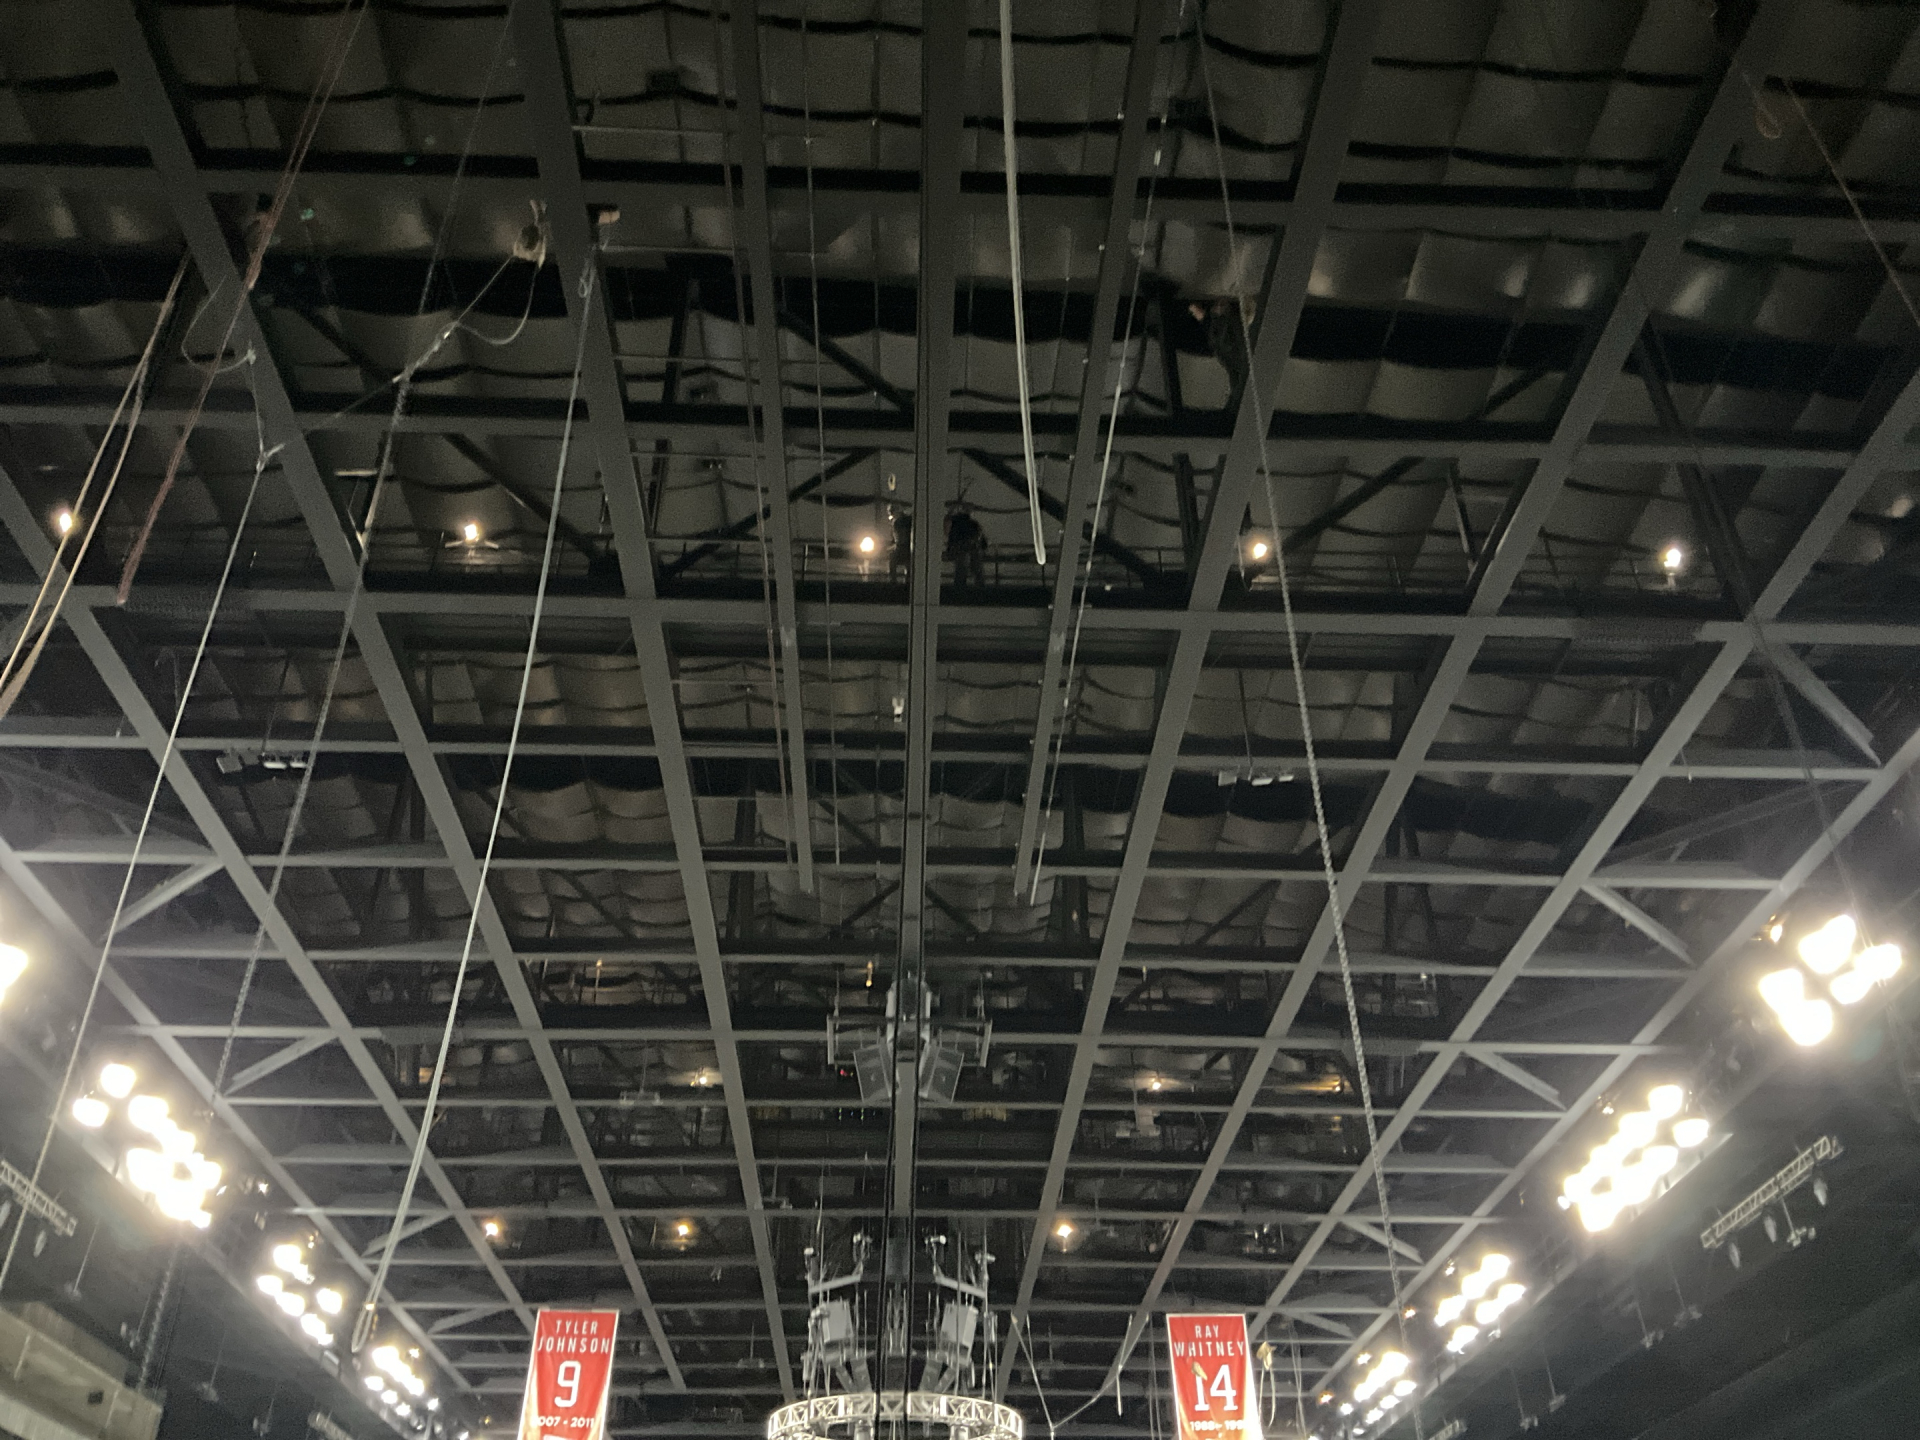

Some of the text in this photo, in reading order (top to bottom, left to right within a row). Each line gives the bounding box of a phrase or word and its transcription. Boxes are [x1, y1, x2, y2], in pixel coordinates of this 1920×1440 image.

[555, 1320, 598, 1335] TYLER
[1195, 1325, 1219, 1339] RAY
[537, 1336, 610, 1354] JOHNSON
[1174, 1341, 1245, 1357] WHITNEY
[554, 1360, 582, 1407] 9
[1194, 1364, 1238, 1411] 14
[531, 1416, 561, 1427] 007
[570, 1417, 595, 1428] 2011
